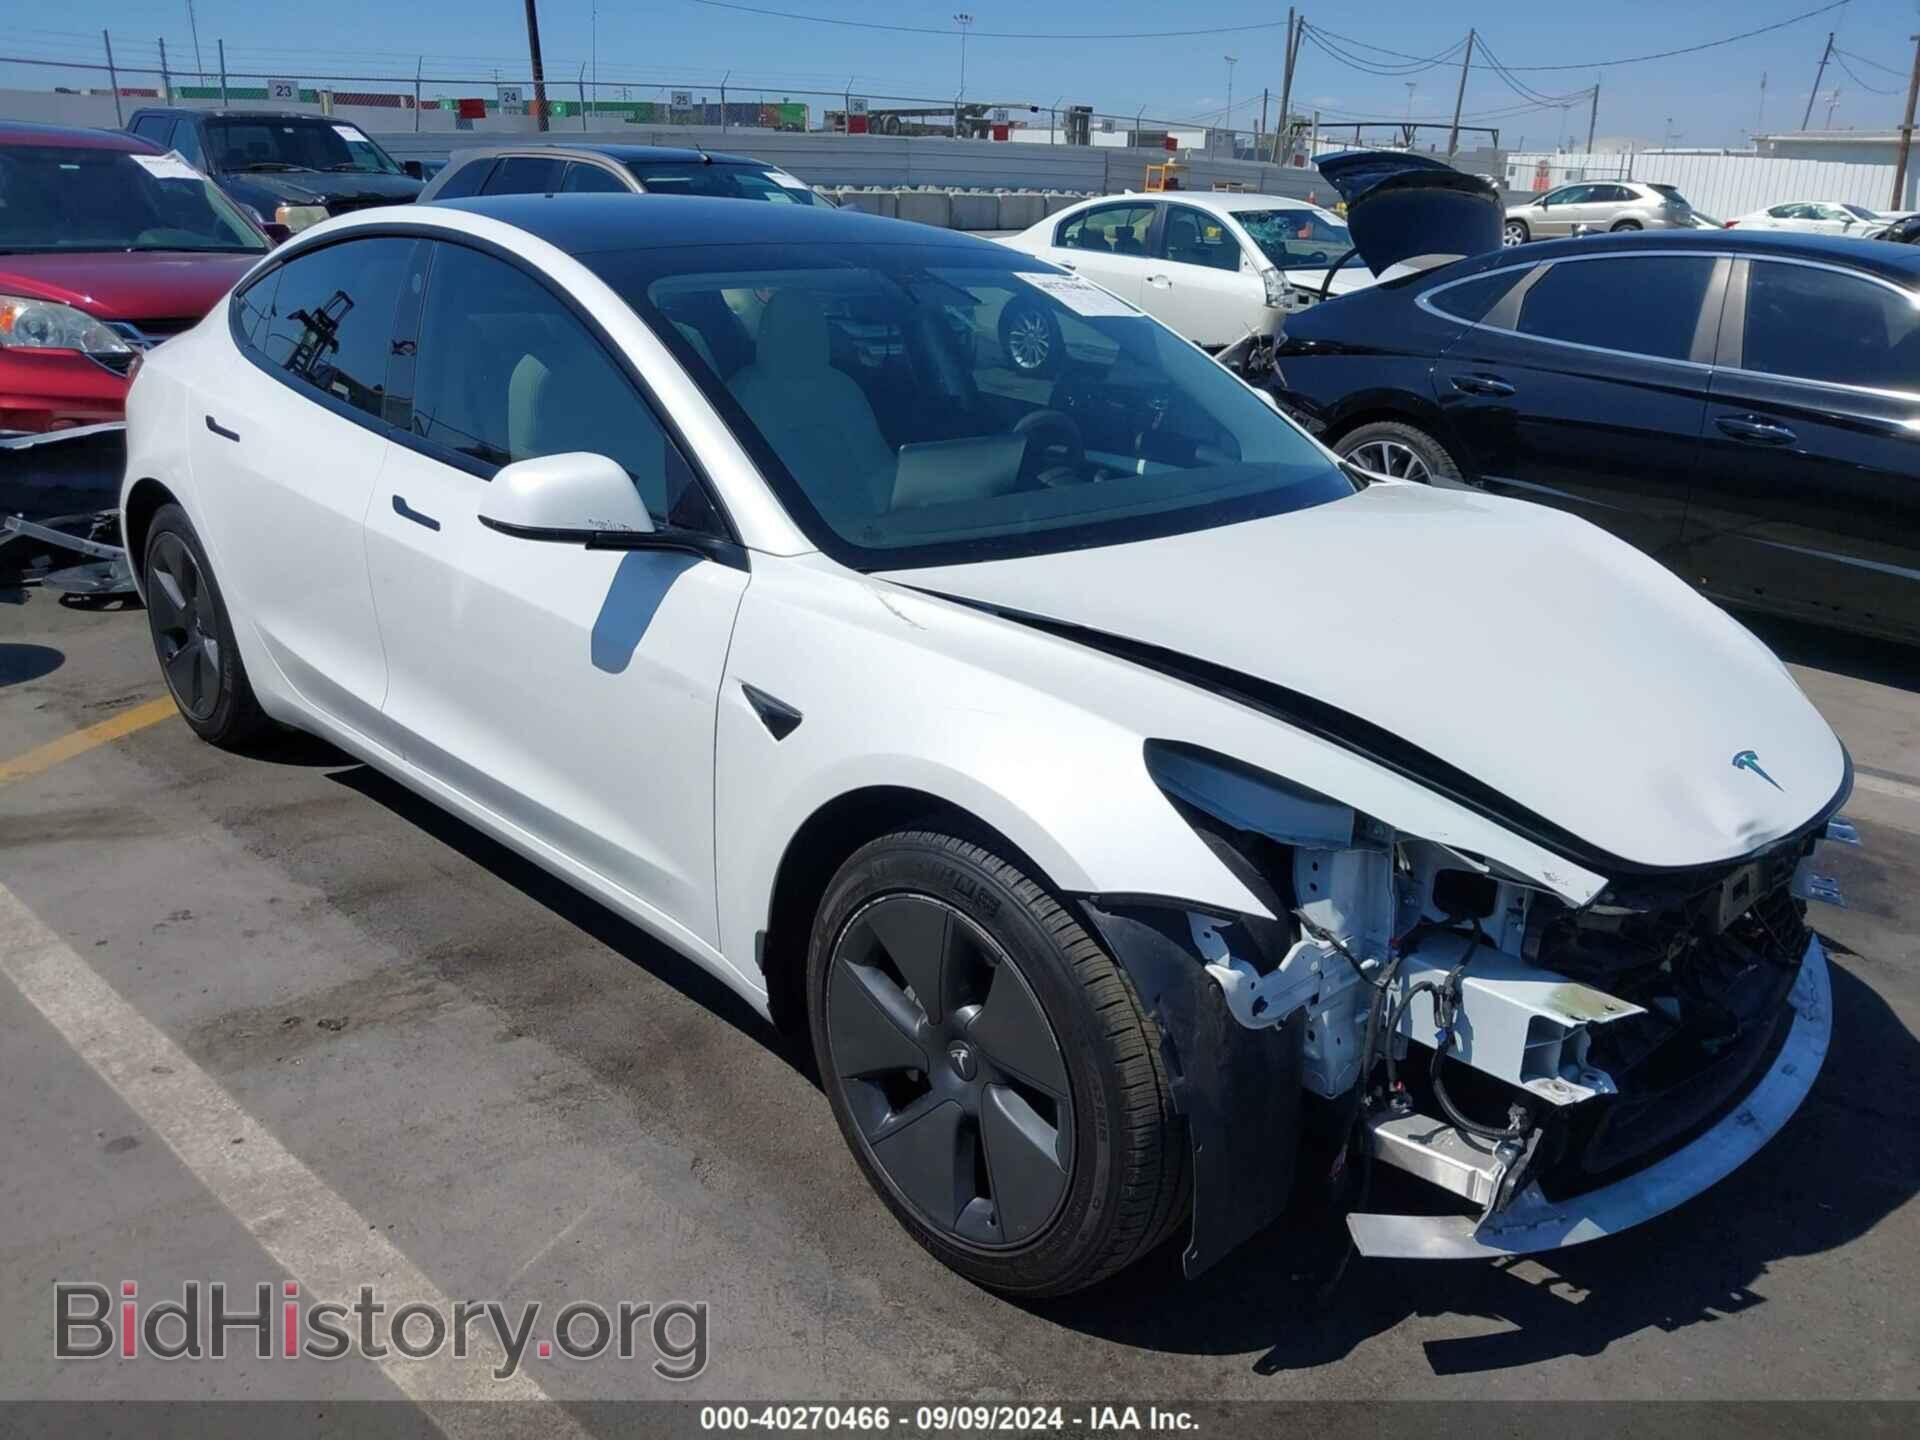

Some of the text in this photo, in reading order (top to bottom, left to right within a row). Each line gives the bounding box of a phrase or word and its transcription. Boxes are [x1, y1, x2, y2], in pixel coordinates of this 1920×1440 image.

[275, 84, 292, 97] 23
[503, 91, 517, 102] 24
[675, 95, 689, 105] 25
